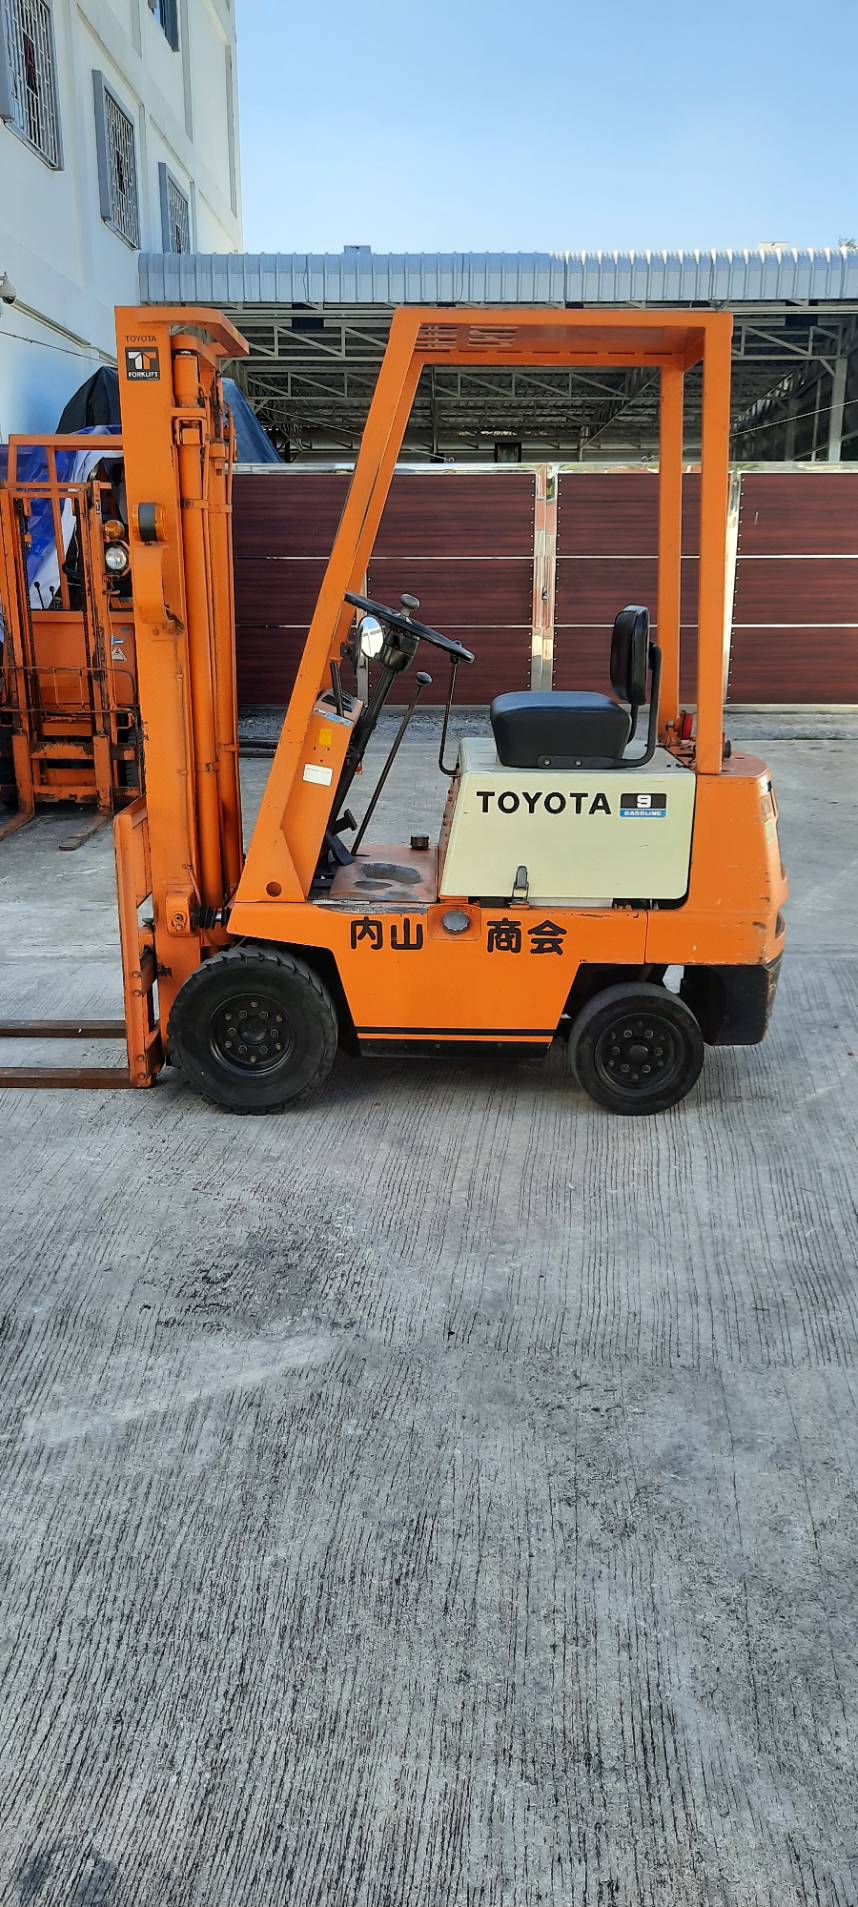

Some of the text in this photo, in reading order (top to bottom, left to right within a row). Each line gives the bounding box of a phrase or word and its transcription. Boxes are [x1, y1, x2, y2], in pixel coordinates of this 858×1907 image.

[476, 791, 612, 815] TOYOTA
[637, 794, 652, 808] 9
[350, 916, 567, 955] 内山 商会
